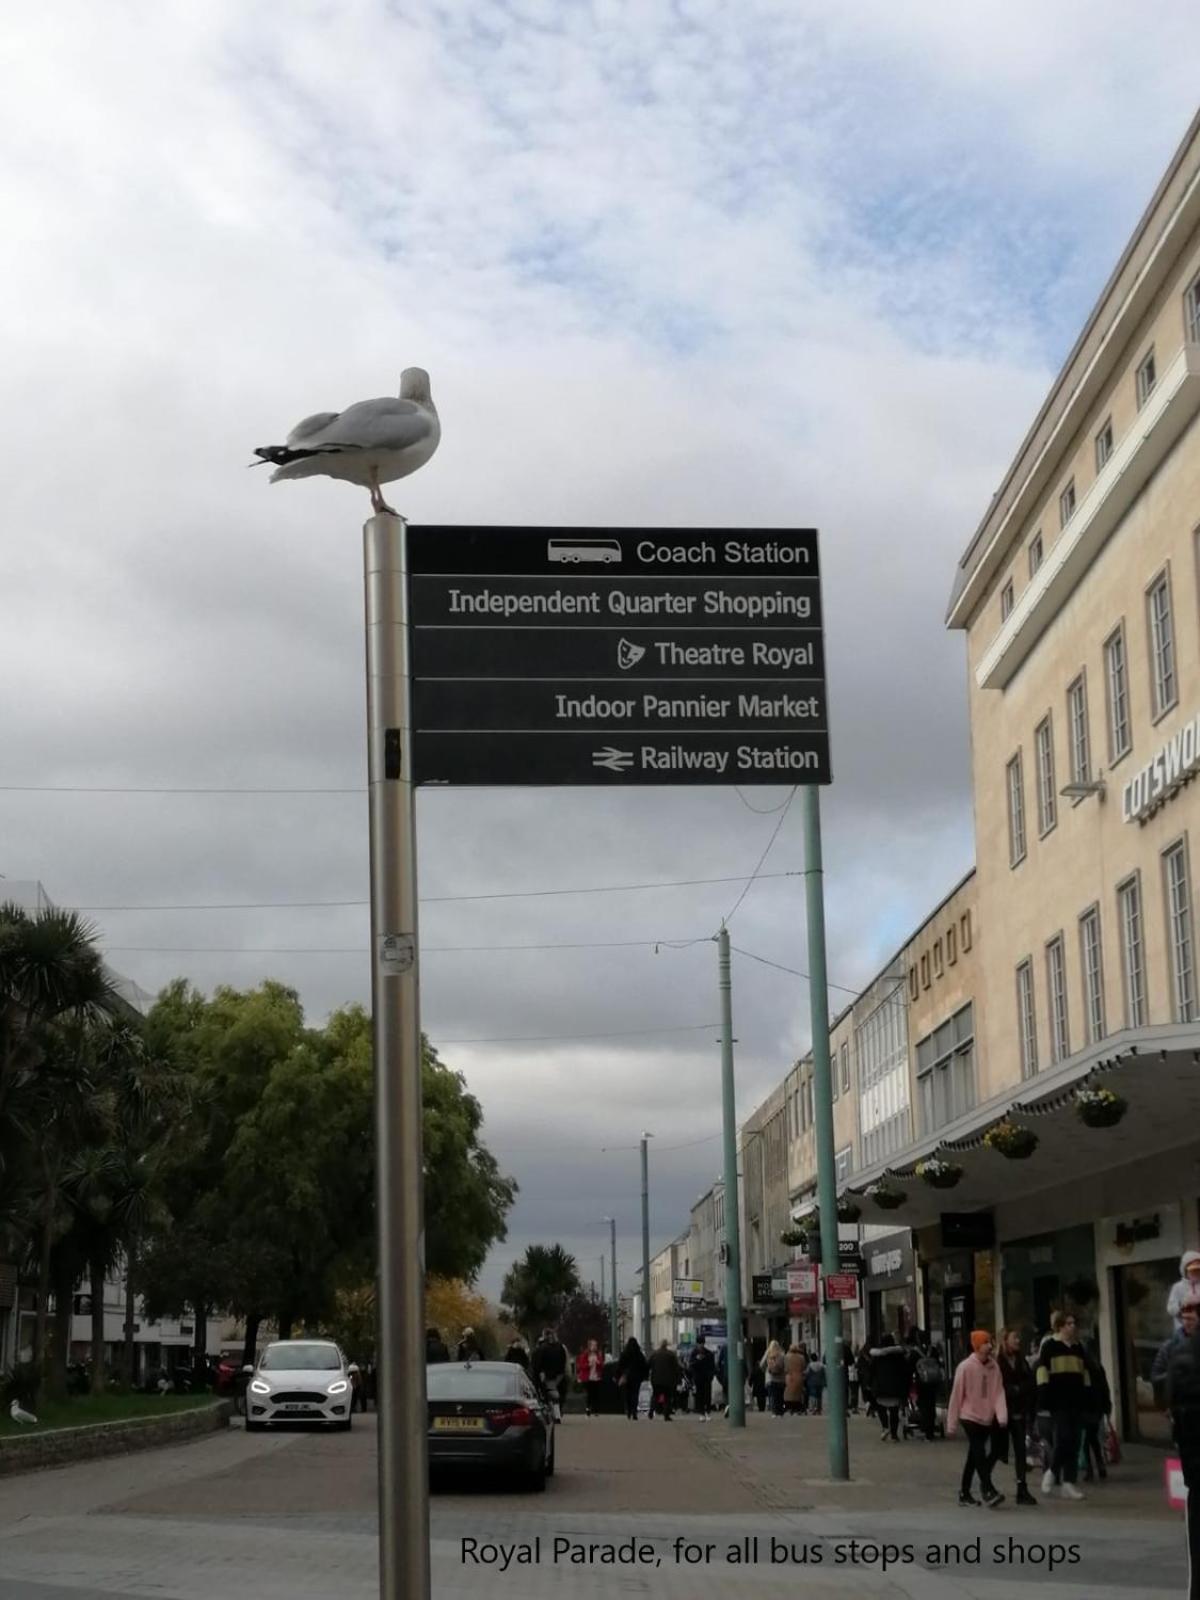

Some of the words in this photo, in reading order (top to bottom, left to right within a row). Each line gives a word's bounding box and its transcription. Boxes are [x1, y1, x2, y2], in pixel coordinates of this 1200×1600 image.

[637, 541, 716, 563] Coach
[724, 541, 810, 563] Station
[448, 589, 600, 617] Independent
[608, 590, 697, 616] Quarter
[704, 590, 811, 618] Shopping
[655, 642, 745, 665] Theatre
[753, 642, 814, 670] Royal
[555, 694, 636, 718] Indoor
[643, 694, 731, 718] Pannier
[738, 694, 819, 718] Market
[641, 746, 729, 773] Railway
[737, 746, 819, 769] Station
